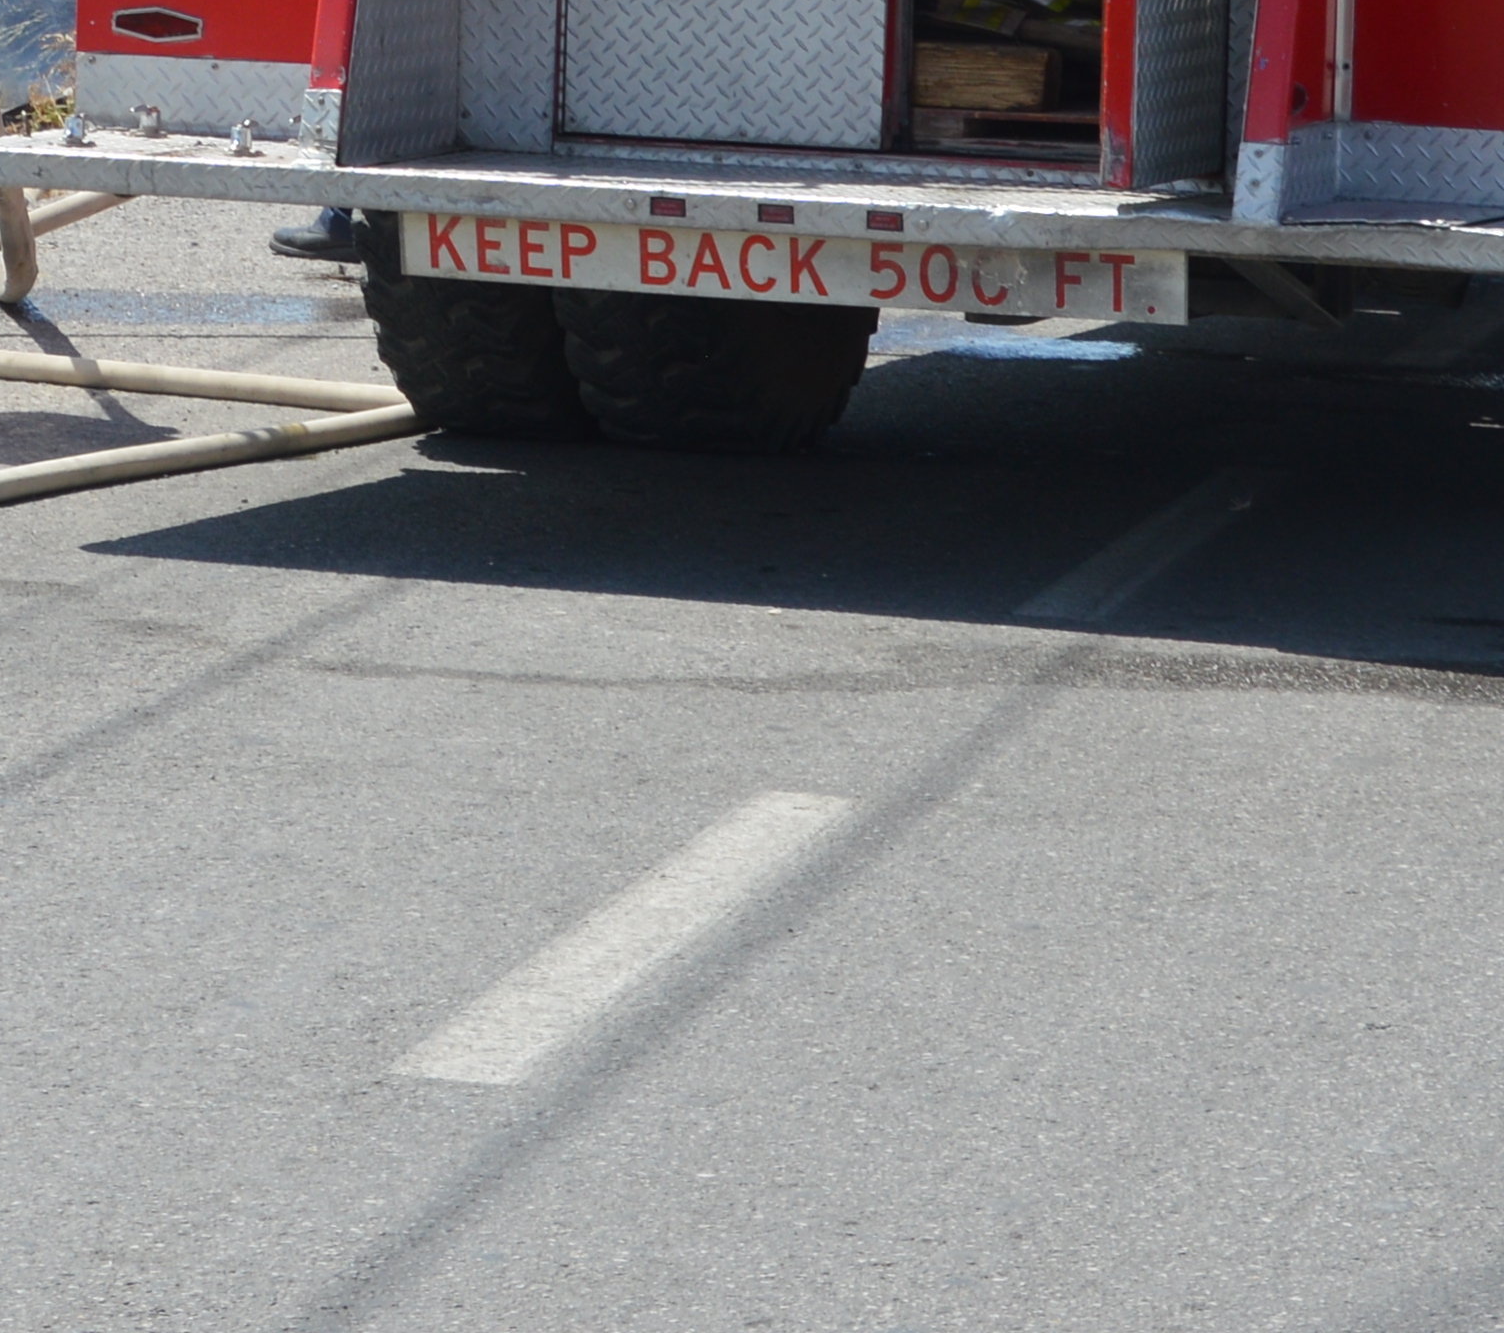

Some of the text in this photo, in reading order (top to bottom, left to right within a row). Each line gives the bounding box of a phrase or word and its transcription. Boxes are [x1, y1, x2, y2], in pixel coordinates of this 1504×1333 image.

[428, 213, 597, 279] KEEP
[638, 228, 829, 296] BACK
[1054, 252, 1156, 315] FT.
